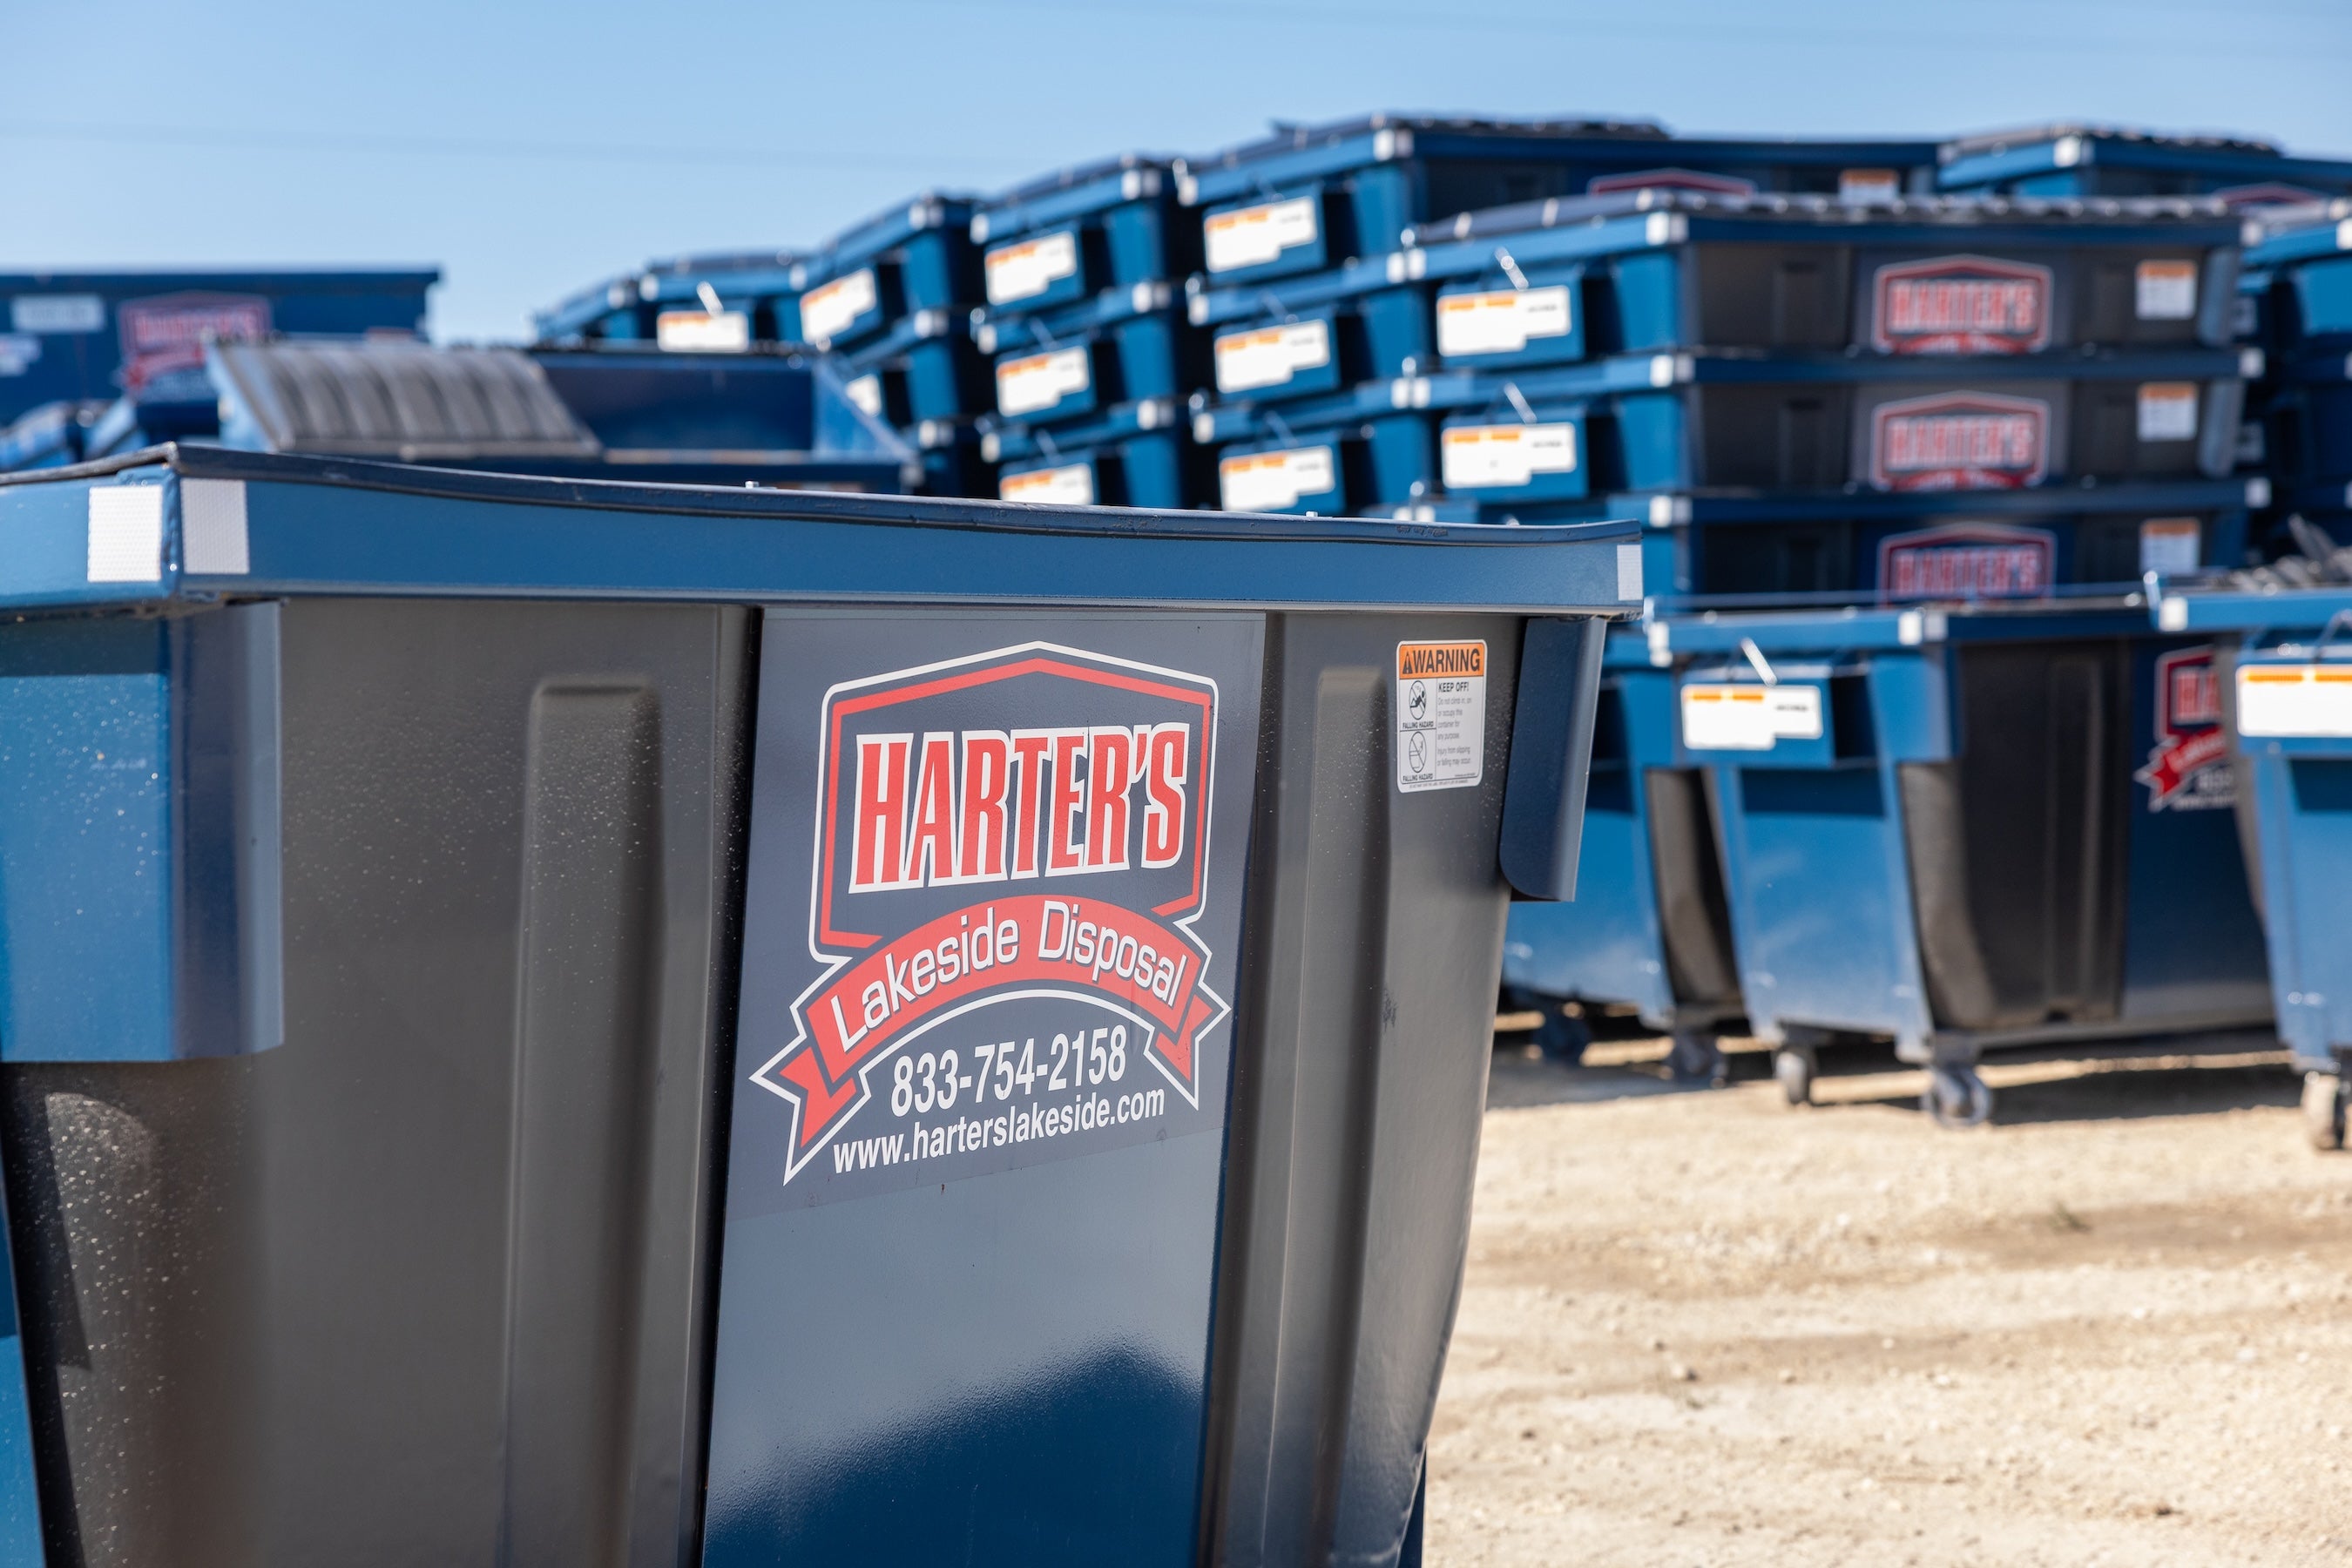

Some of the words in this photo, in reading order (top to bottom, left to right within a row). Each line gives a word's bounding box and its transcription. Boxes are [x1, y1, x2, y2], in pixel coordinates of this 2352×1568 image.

[1412, 648, 1481, 673] WARNING
[1438, 682, 1454, 693] KEEP
[1456, 681, 1470, 692] OFF!
[848, 722, 1191, 894] HARTER'S
[831, 906, 1020, 1053] Lakeside
[1037, 900, 1187, 1007] Disposal
[891, 1024, 1128, 1118] 833-754-2158
[833, 1088, 1166, 1174] www.harterslakeside.com
